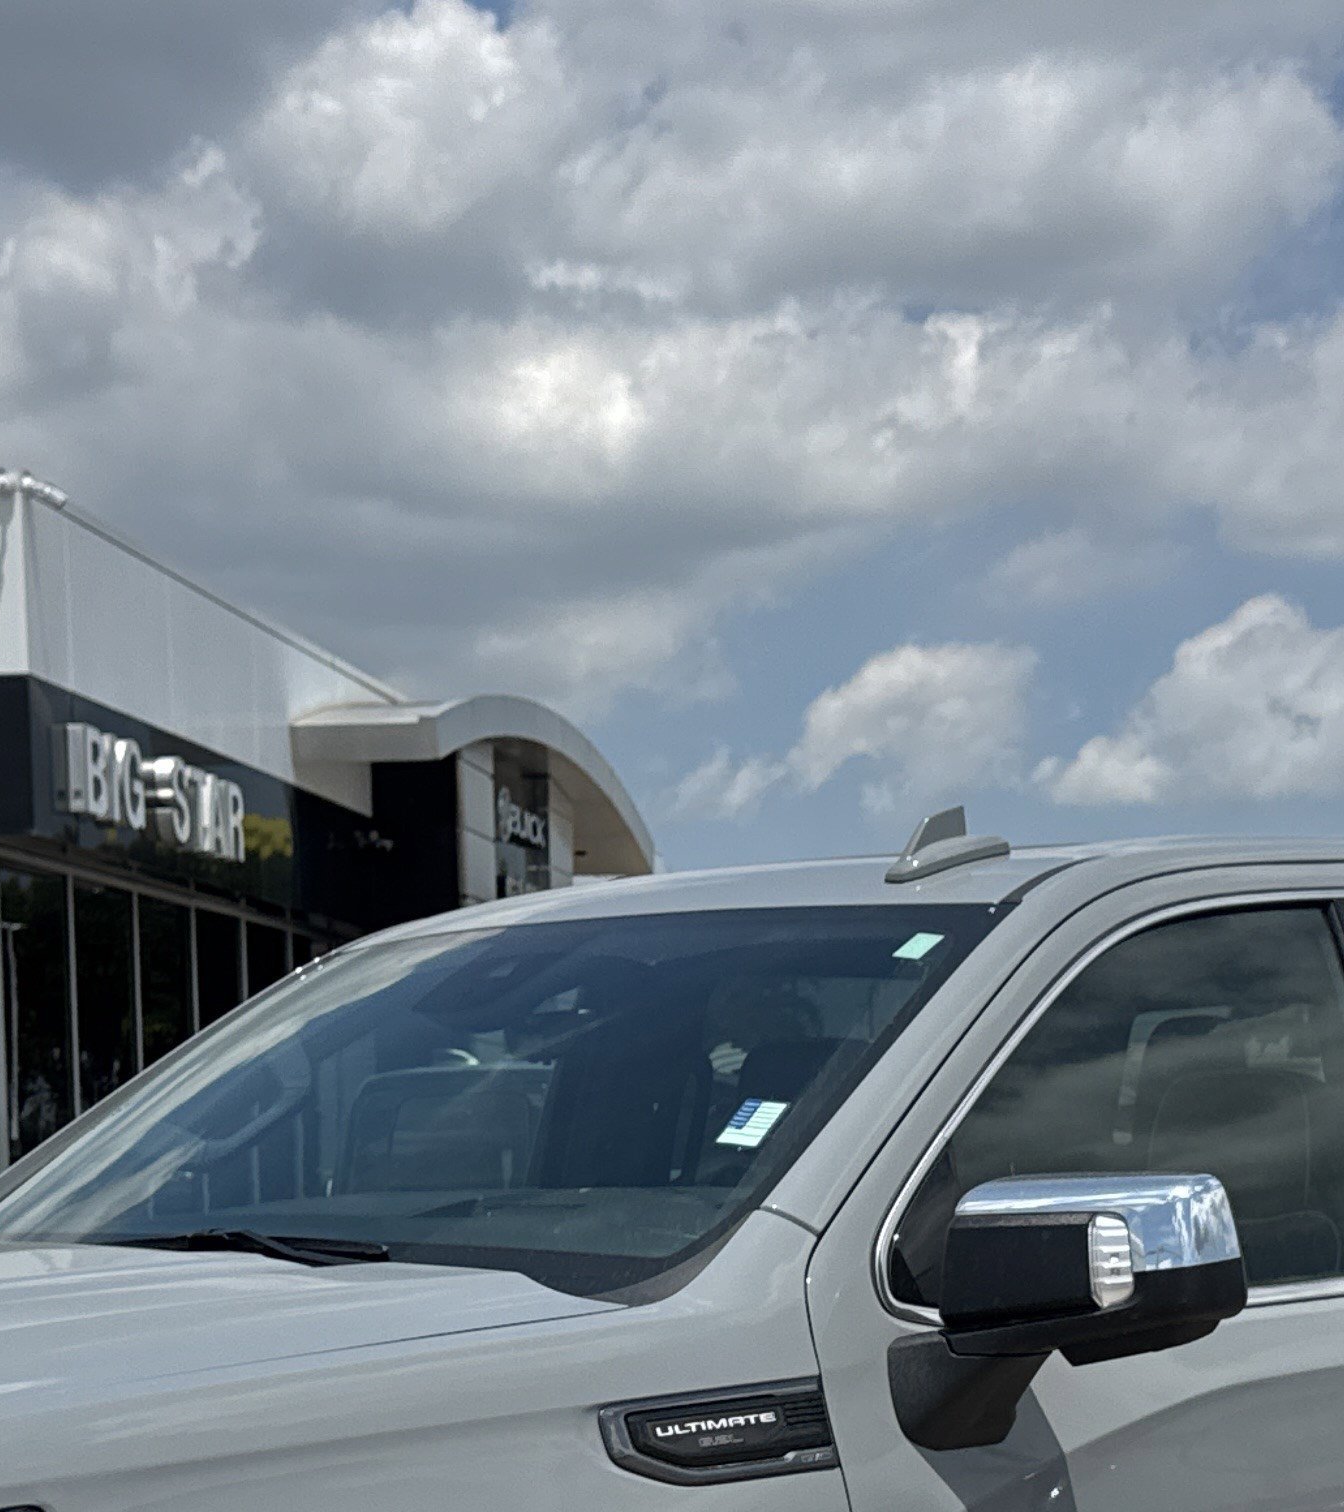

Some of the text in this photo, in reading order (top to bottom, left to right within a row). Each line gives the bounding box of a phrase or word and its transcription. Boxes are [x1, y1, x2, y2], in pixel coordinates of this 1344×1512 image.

[80, 723, 246, 863] BIG STAR
[655, 1411, 776, 1437] ULTIMATE
